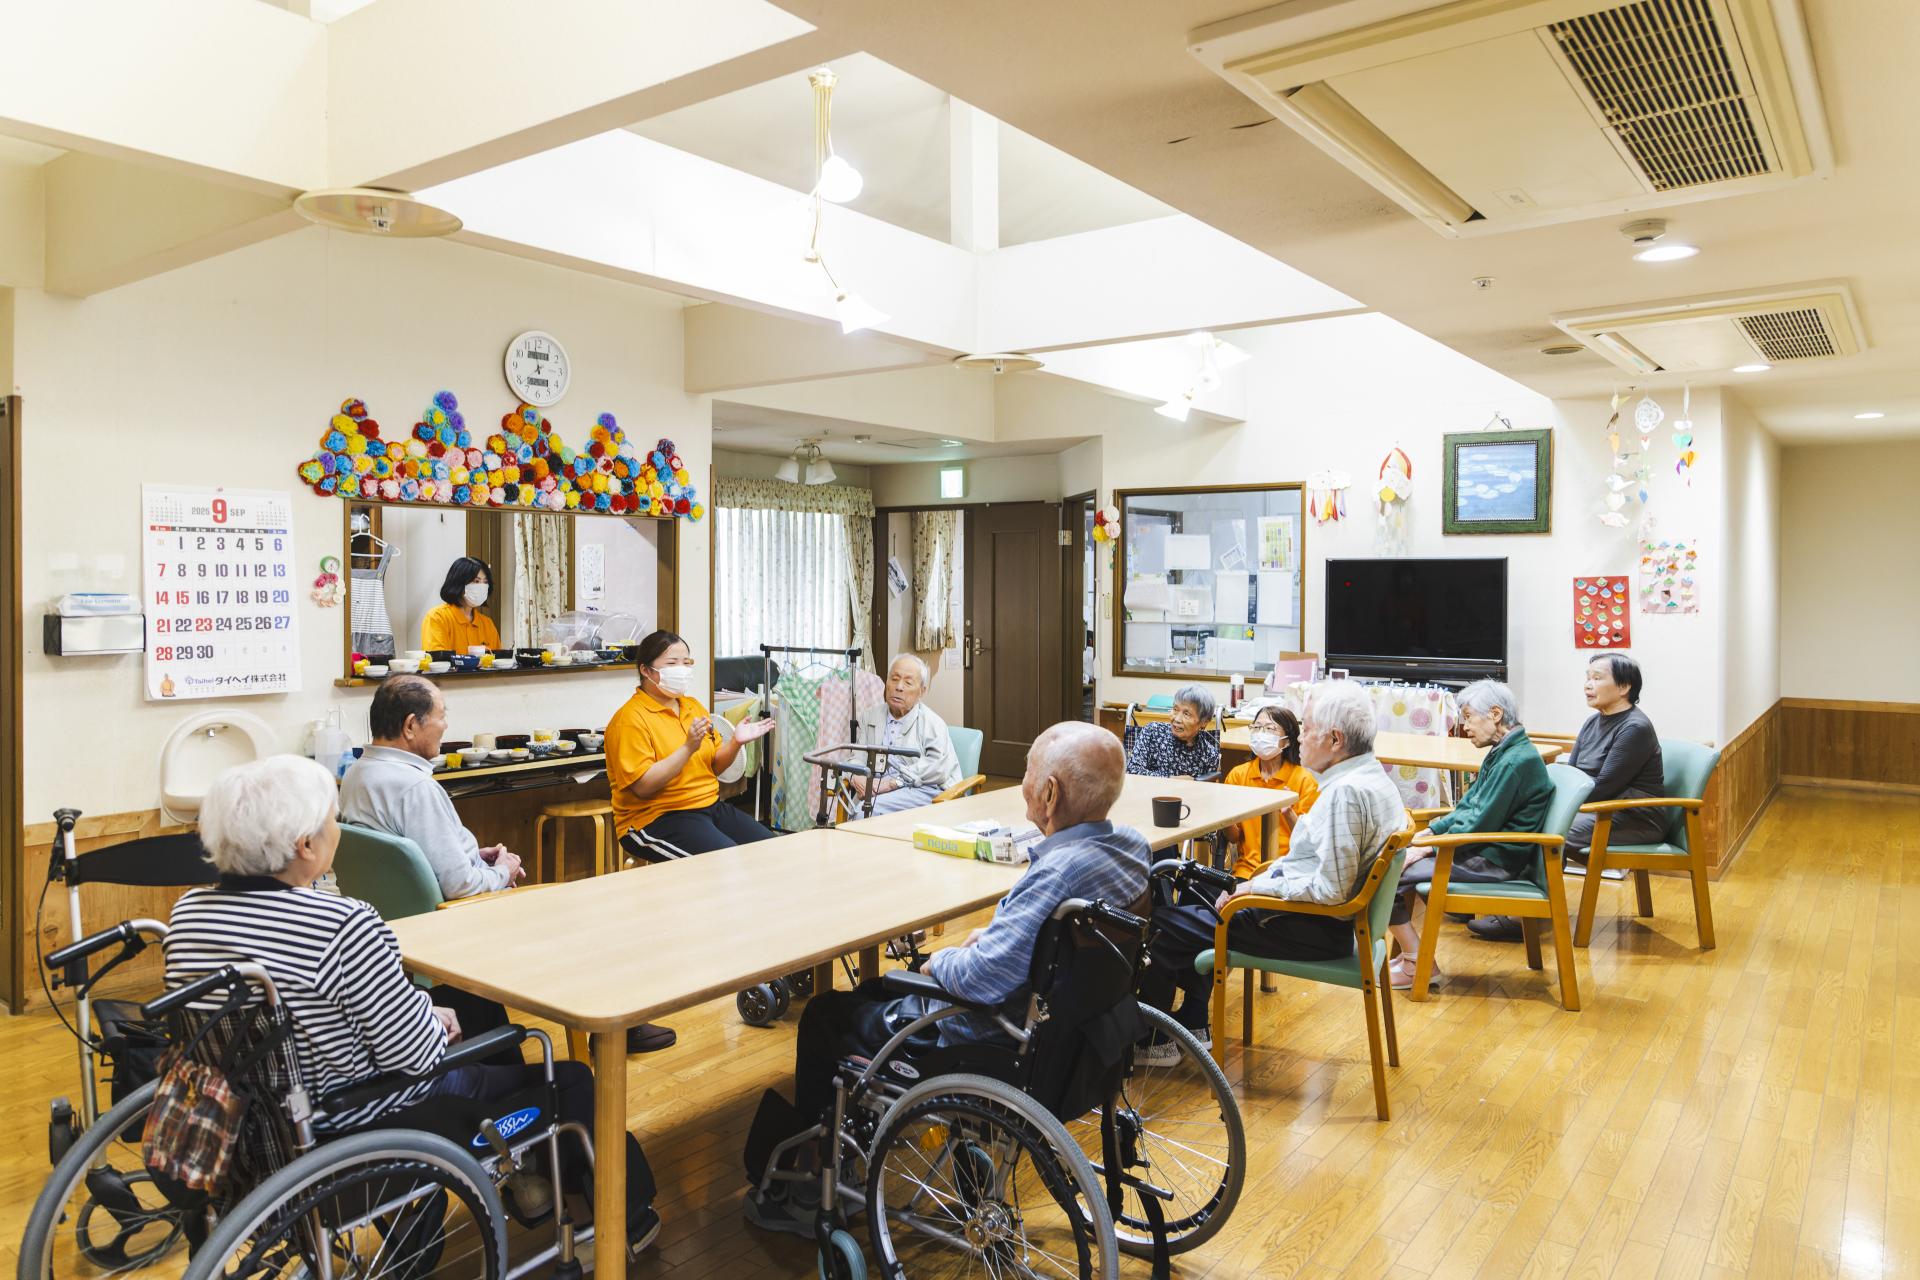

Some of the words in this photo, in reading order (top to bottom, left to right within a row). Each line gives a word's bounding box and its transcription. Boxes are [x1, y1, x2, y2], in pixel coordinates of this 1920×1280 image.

[192, 507, 210, 515] 2025
[212, 499, 227, 523] 9
[180, 536, 183, 549] 1
[197, 537, 205, 549] 2
[217, 537, 225, 550] 3
[236, 538, 244, 550] 4
[255, 538, 263, 550] 5
[274, 538, 282, 551] 6
[158, 563, 165, 576] 7
[178, 564, 186, 577] 8
[198, 564, 206, 577] 9
[216, 564, 228, 577] 10
[236, 564, 246, 577] 11
[255, 564, 266, 577] 12
[273, 564, 285, 577] 13
[156, 591, 169, 605] 14
[177, 591, 189, 604] 15
[197, 591, 209, 604] 16
[217, 591, 228, 604] 17
[237, 591, 248, 603] 18
[256, 591, 268, 603] 19
[273, 590, 289, 603] 20
[157, 619, 170, 632] 21
[176, 619, 192, 632] 22
[196, 618, 212, 631] 23
[216, 618, 232, 631] 24
[236, 617, 252, 630] 25
[255, 617, 271, 629] 26
[275, 616, 290, 629] 27
[156, 647, 172, 660] 28
[177, 646, 193, 660] 29
[197, 645, 213, 658] 30
[215, 674, 286, 686] タイヘイ株式会社
[928, 839, 959, 852] nepia
